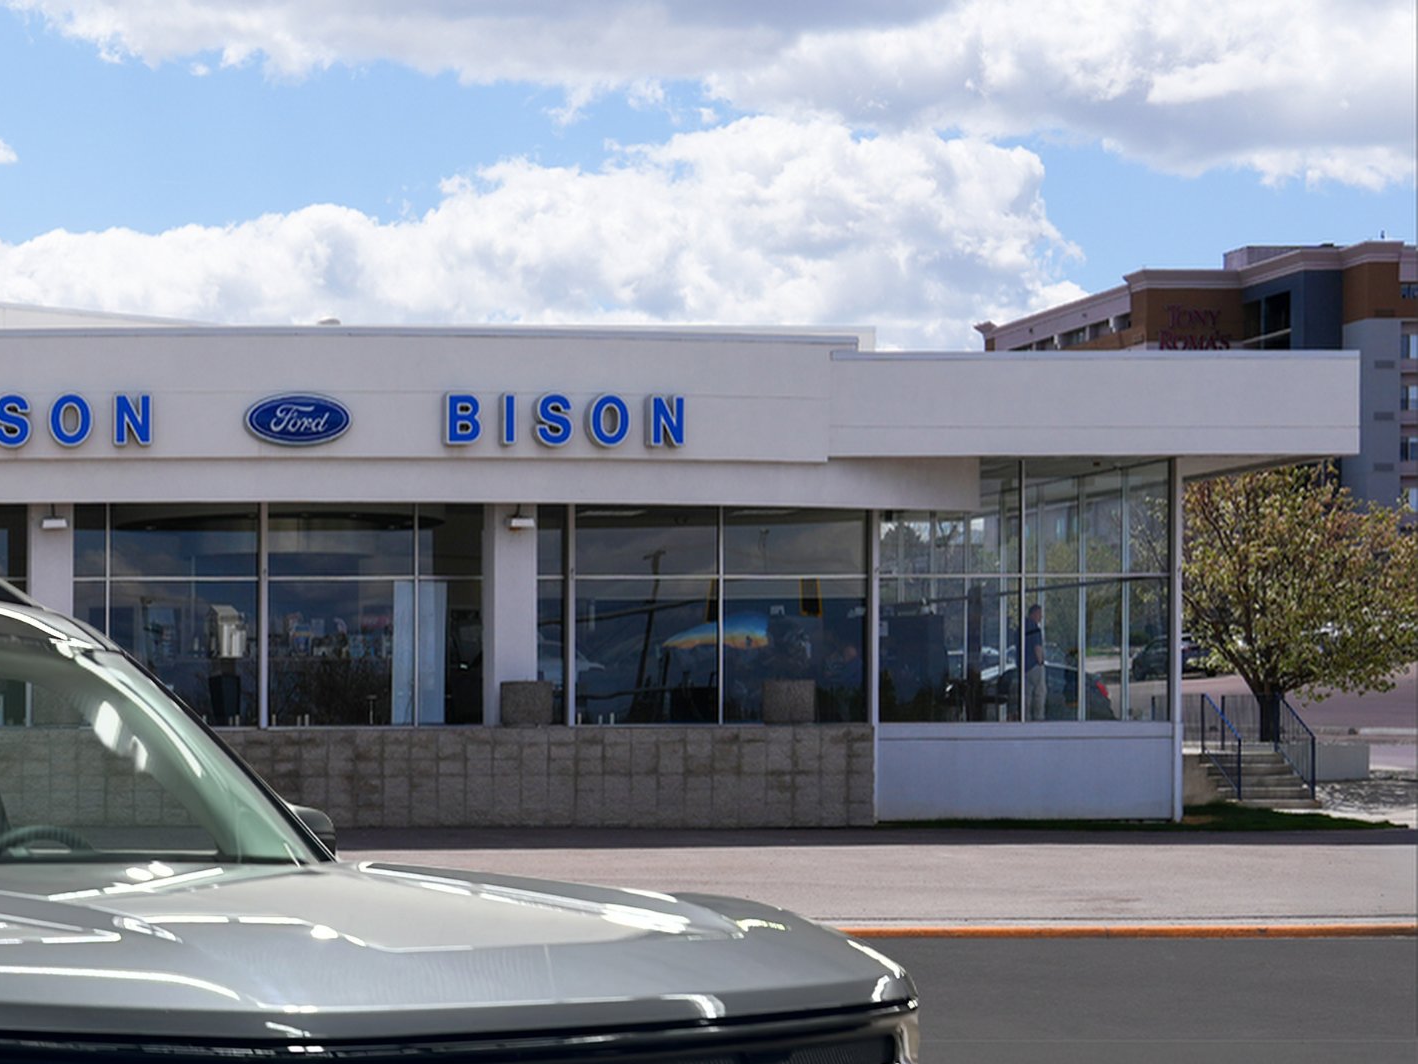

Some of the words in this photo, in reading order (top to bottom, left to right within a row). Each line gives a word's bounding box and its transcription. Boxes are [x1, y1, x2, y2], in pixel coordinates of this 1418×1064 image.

[1164, 304, 1223, 329] TONY
[269, 403, 330, 432] Ford
[444, 393, 685, 447] BISON
